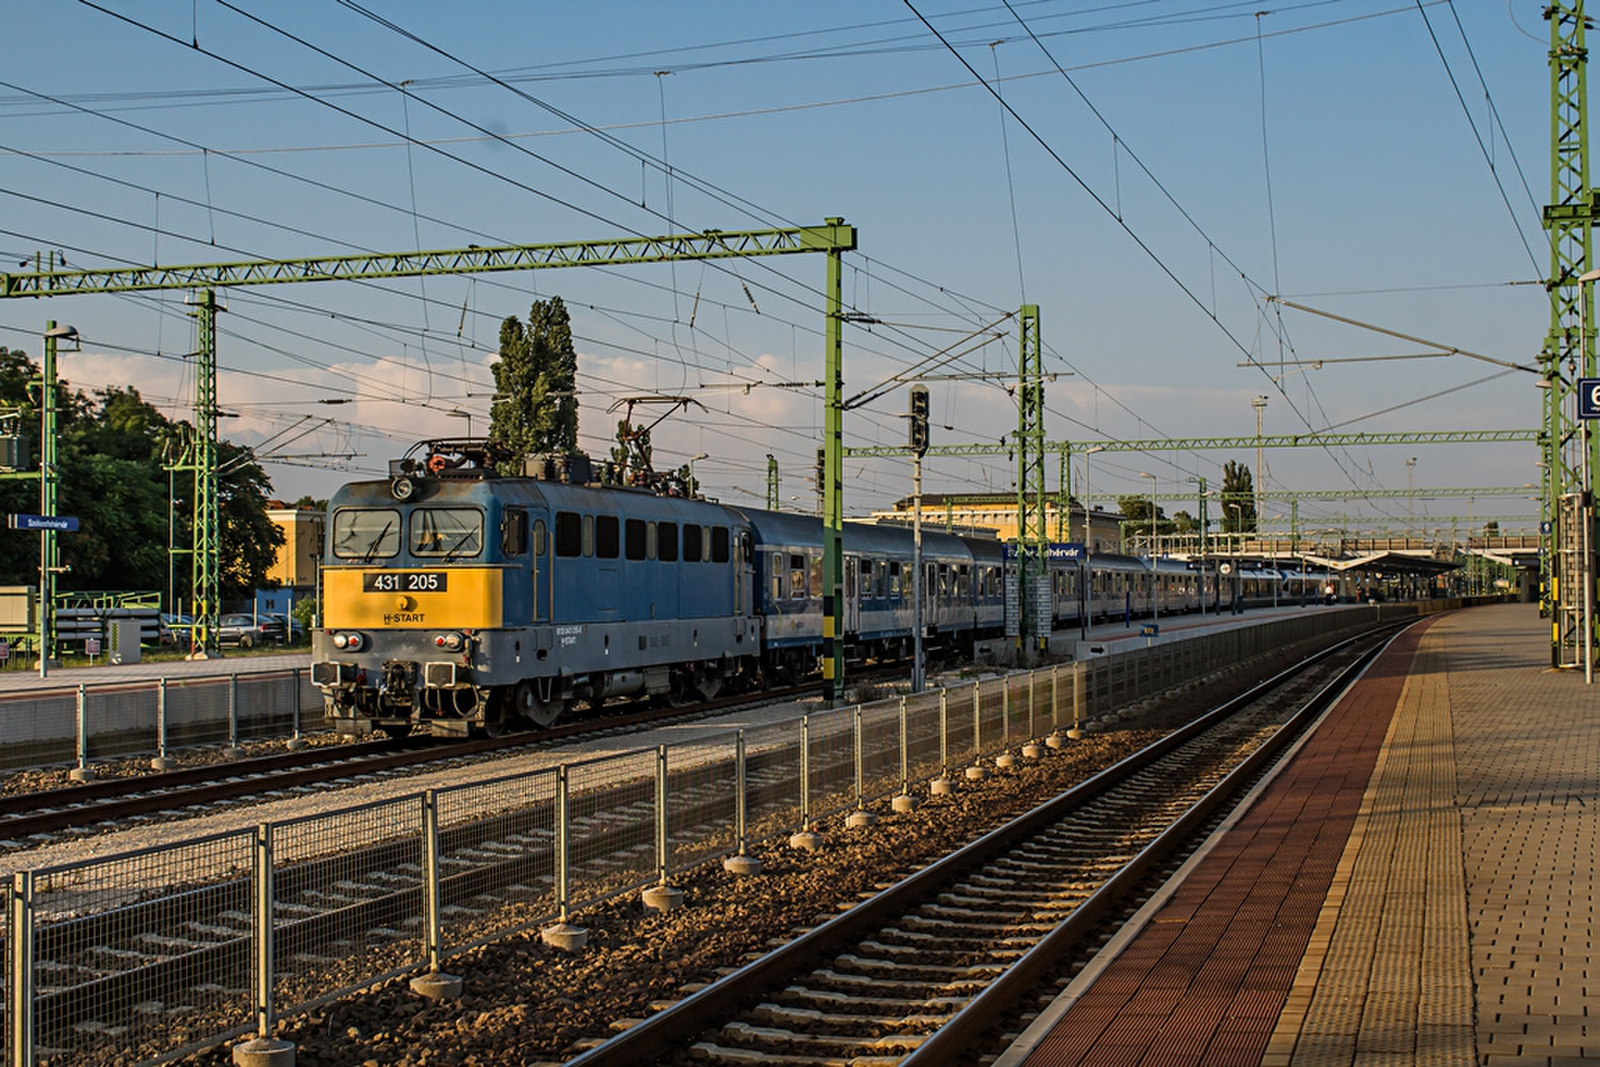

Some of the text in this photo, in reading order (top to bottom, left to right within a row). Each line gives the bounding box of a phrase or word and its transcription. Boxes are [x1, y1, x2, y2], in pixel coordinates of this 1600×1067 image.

[374, 575, 438, 589] 431 205
[384, 614, 425, 622] H-START
